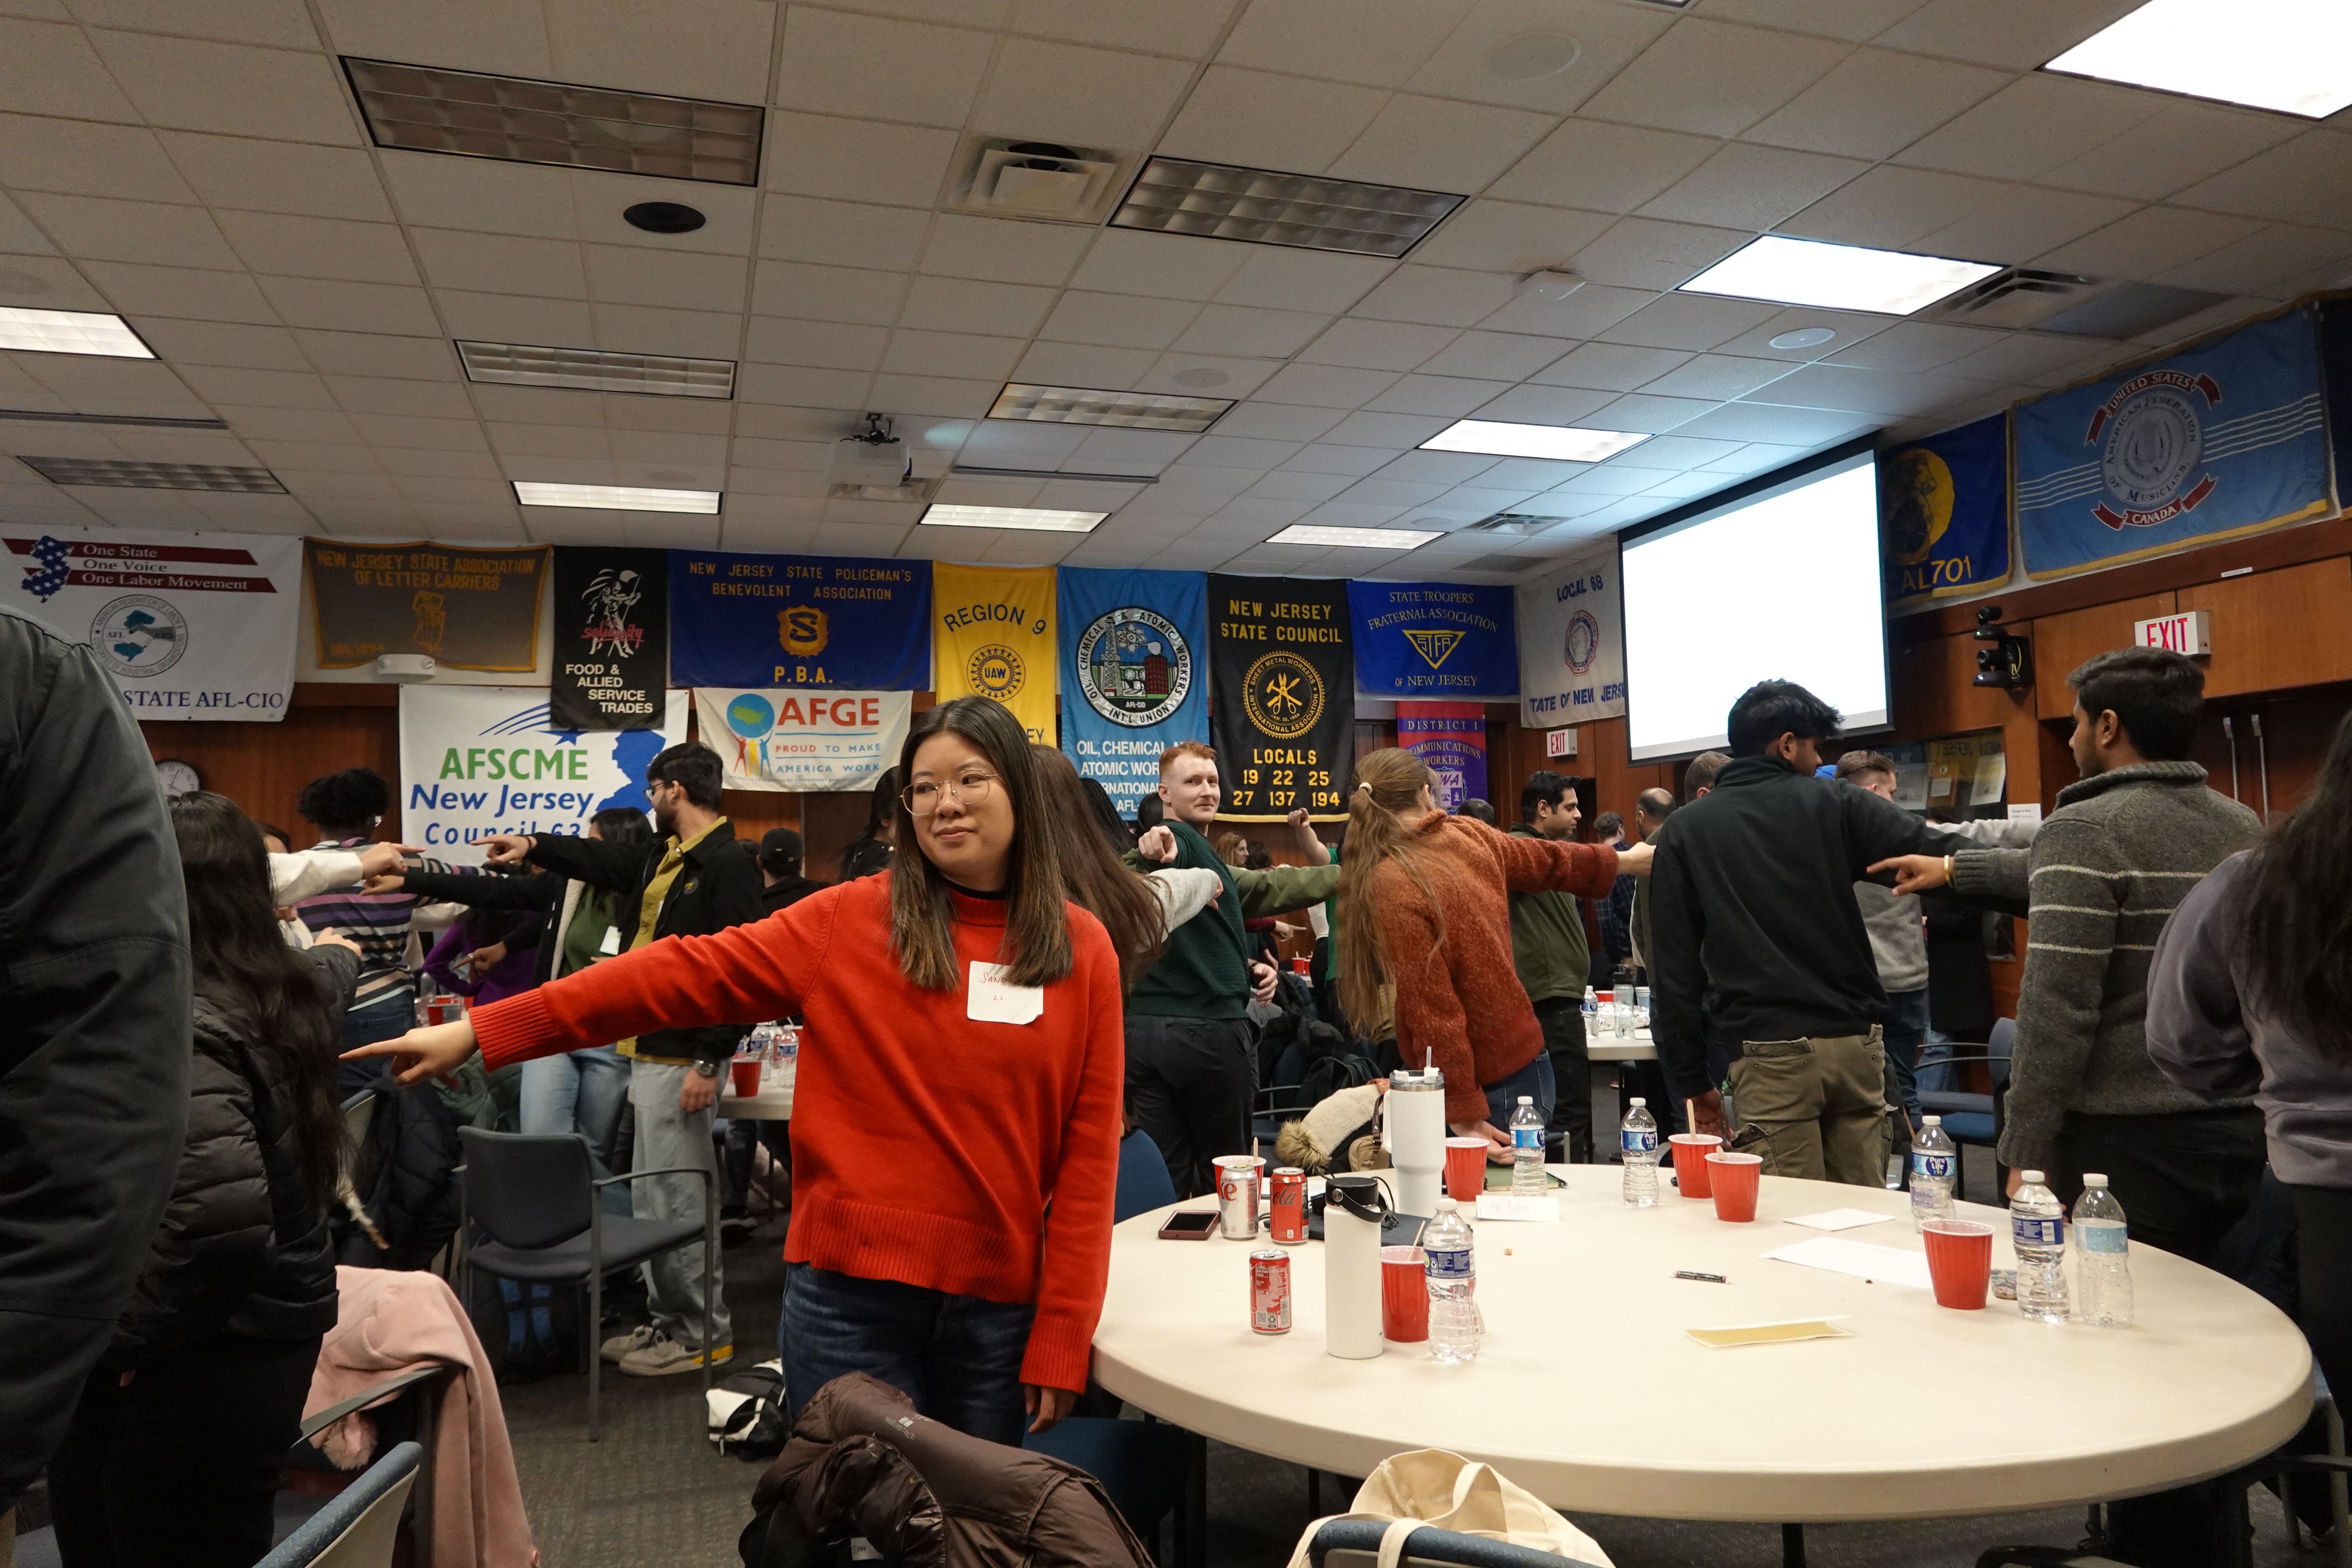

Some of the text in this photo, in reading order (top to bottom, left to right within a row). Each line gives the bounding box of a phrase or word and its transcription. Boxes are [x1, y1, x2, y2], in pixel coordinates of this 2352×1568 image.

[2110, 373, 2192, 408] UNITED STATES
[2106, 396, 2196, 465] AMERICAN FEDERATION
[2109, 476, 2121, 489] OF
[2132, 505, 2177, 524] CANADA
[83, 545, 158, 558] One State
[83, 559, 168, 573] One Voice
[317, 550, 536, 574] NEW JERSEY STATE ASSOCIATION
[1930, 555, 1972, 584] 701
[690, 562, 912, 582] NEW JERSEY STATE POLICEMAN'S
[82, 573, 248, 590] One Labor Movement
[354, 571, 500, 591] OF LETTER CARRIERS
[1557, 575, 1603, 602] LOCAL 68
[713, 583, 891, 600] BENEVOLENT ASSOCIATION
[1390, 591, 1474, 603] STATE TROOPERS
[1230, 600, 1332, 620] NEW JERSEY
[943, 603, 1046, 635] REGION 9
[1368, 608, 1498, 633] FRATERNAL ASSOCIATION
[1221, 623, 1343, 643] STATE COUNCIL
[2147, 617, 2188, 652] EXIT
[1080, 623, 1104, 670] CHEMICAL
[1121, 612, 1128, 620] &
[1139, 612, 1176, 639] ATOMIC
[1176, 646, 1188, 696] WORKERS
[565, 664, 620, 675] FOOD &
[775, 666, 833, 684] P.B.A.
[984, 668, 1006, 679] UAW
[1250, 657, 1315, 686] SHEET METAL WORKERS
[577, 677, 623, 688] ALLIED
[1407, 675, 1435, 686] NEW
[1438, 674, 1477, 686] JERSEY
[124, 690, 284, 709] STATE AFL-CIO
[588, 689, 646, 701] SERVICE
[1529, 695, 1556, 713] TATE
[1573, 687, 1594, 705] NEW
[599, 702, 653, 714] TRADES
[777, 698, 880, 727] AFGE
[1140, 704, 1170, 723] UNION
[1249, 694, 1319, 732] INTERNATIONAL ASSOCIATION
[1407, 720, 1478, 730] DISTRICT 1
[775, 743, 881, 753] PROUD TO MAKE
[1077, 740, 1101, 757] OIL,
[1102, 740, 1164, 756] CHEMICAL
[1409, 741, 1481, 760] OMMUNICATIONS
[1550, 732, 1566, 754] EXIT
[439, 748, 588, 780] AFSCME
[1253, 748, 1317, 765] LOCALS
[1423, 755, 1465, 766] WORKERS
[776, 763, 880, 773] AMERICA WORK
[1080, 761, 1129, 776] ATOMIC
[1243, 769, 1329, 786] 19 22 25
[1441, 774, 1459, 786] WA
[410, 784, 594, 818] New Jersey
[1116, 799, 1140, 812] AFL-
[1234, 791, 1341, 807] 27 137 194
[980, 972, 1007, 983] SAND
[1931, 1162, 1944, 1172] Life
[1221, 1173, 1233, 1182] Diet
